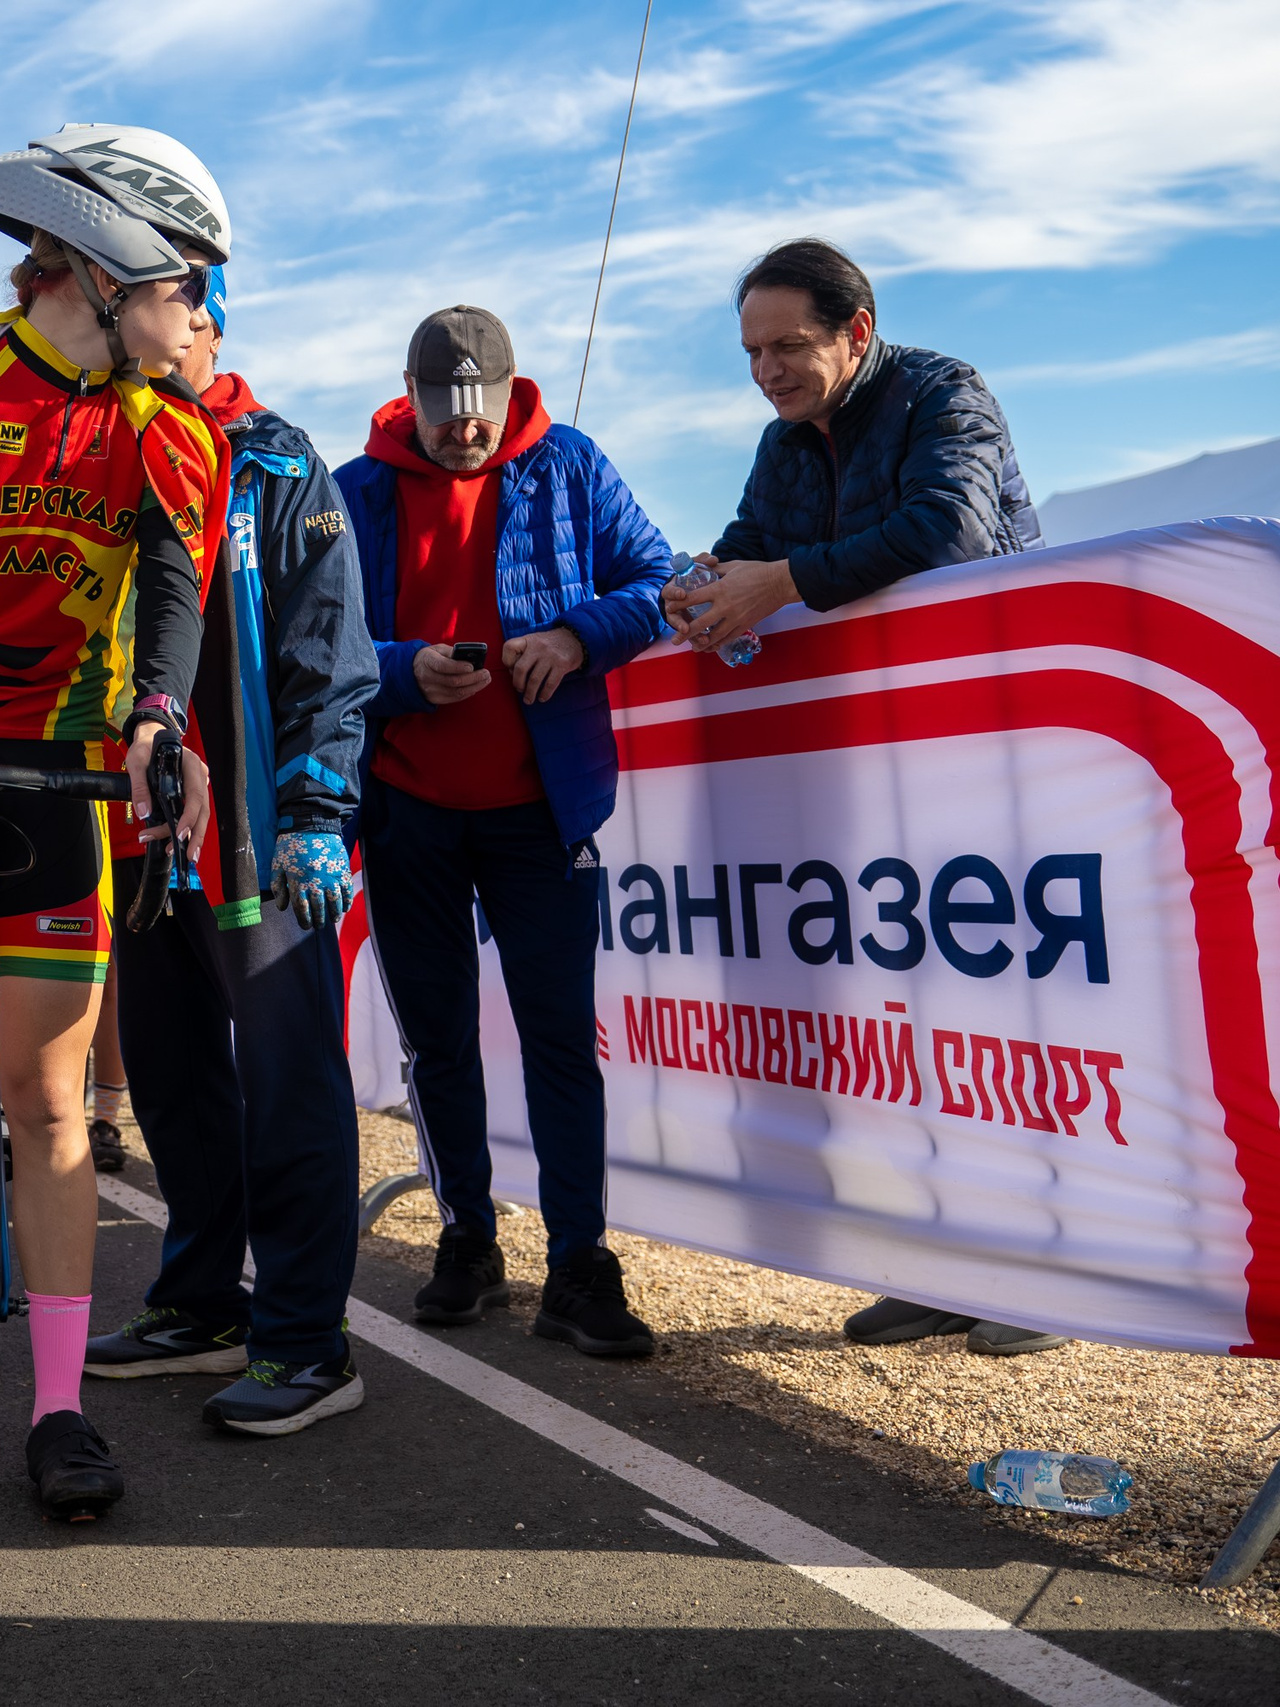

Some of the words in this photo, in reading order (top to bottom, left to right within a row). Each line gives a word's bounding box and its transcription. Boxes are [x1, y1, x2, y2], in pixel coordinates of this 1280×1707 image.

[87, 160, 222, 240] LAZER
[452, 368, 481, 377] adidas
[0, 424, 26, 441] NW
[304, 510, 345, 530] NATIO
[318, 523, 348, 536] TEA
[574, 860, 597, 869] adidas
[49, 921, 81, 931] Newish
[623, 994, 923, 1107] МОСКОВСКИЙ
[931, 1028, 1129, 1146] СПОРТ
